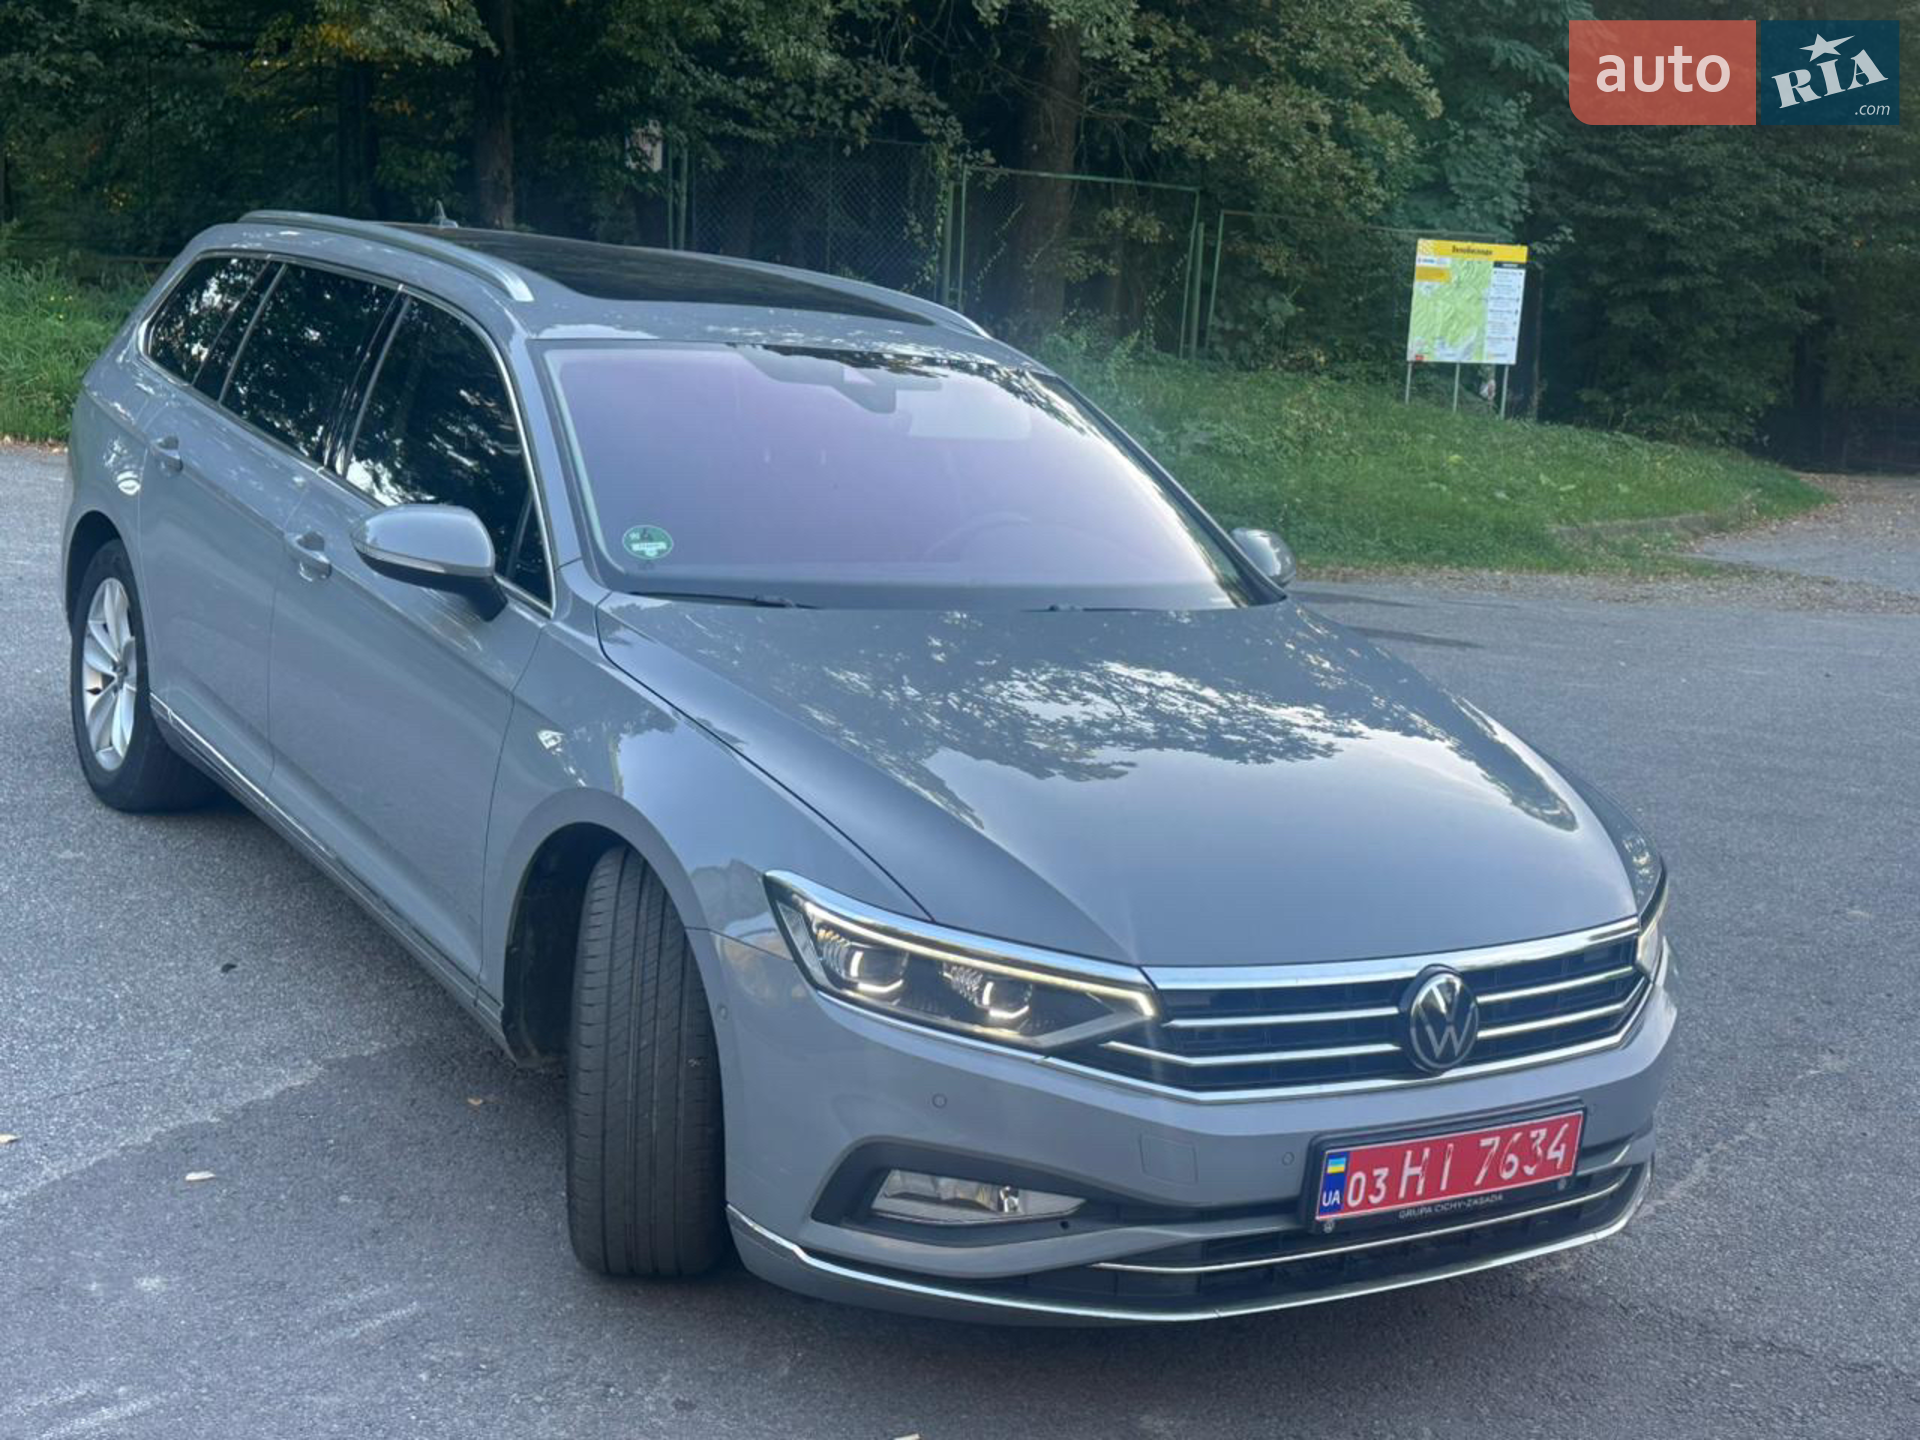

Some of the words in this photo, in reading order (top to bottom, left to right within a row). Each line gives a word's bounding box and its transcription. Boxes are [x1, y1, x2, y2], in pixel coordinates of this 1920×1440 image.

[1347, 1167, 1389, 1208] 03
[1474, 1123, 1570, 1187] 7634
[1322, 1189, 1341, 1207] UA
[1398, 1206, 1433, 1219] GRUPA
